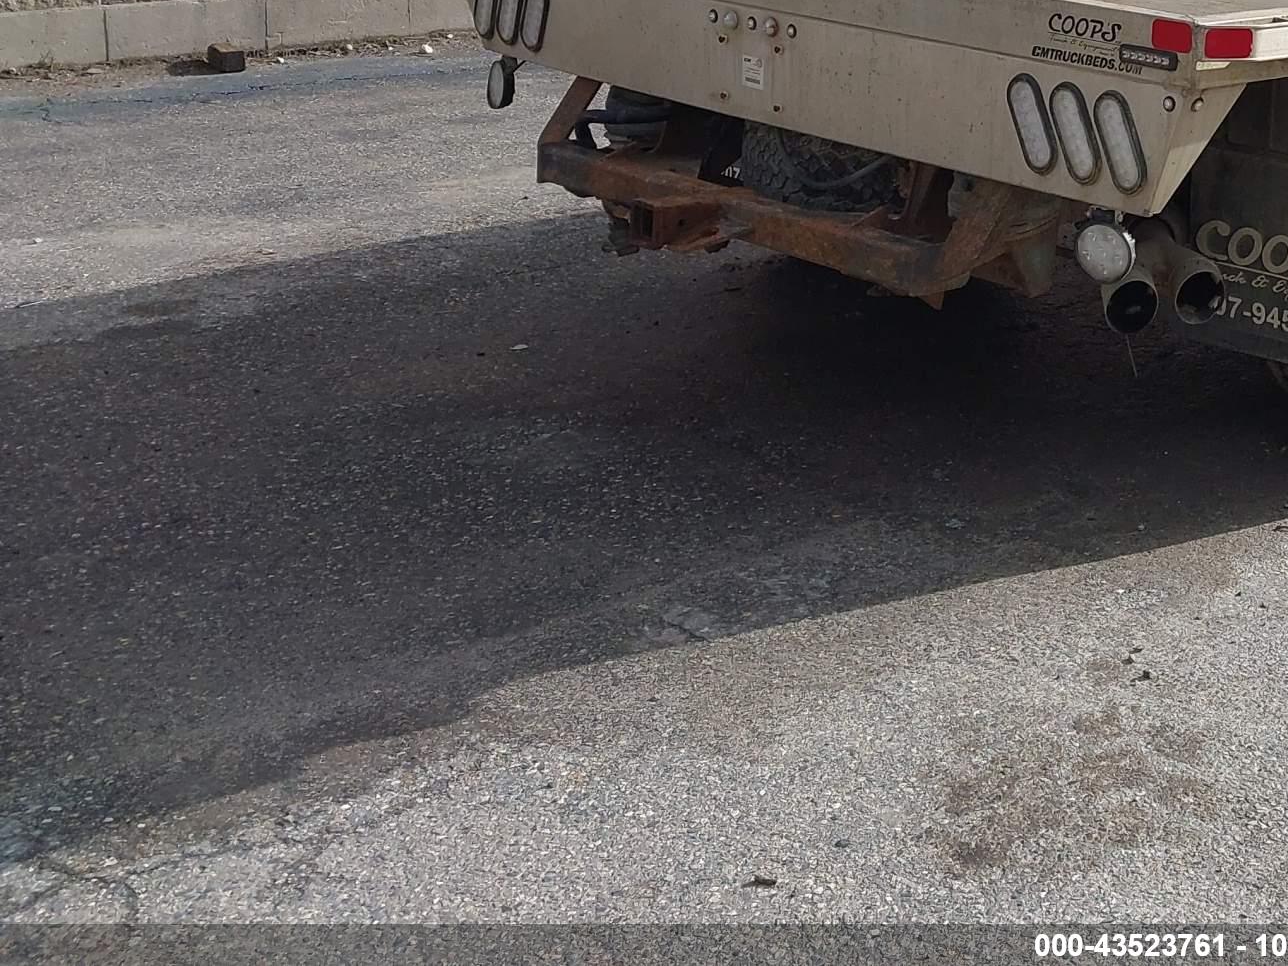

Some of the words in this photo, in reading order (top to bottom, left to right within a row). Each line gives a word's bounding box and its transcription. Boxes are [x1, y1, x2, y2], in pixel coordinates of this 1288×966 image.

[1048, 13, 1122, 42] COOP'S
[1031, 45, 1143, 75] CMTRUCKBEDS.COM
[1251, 275, 1270, 288] &
